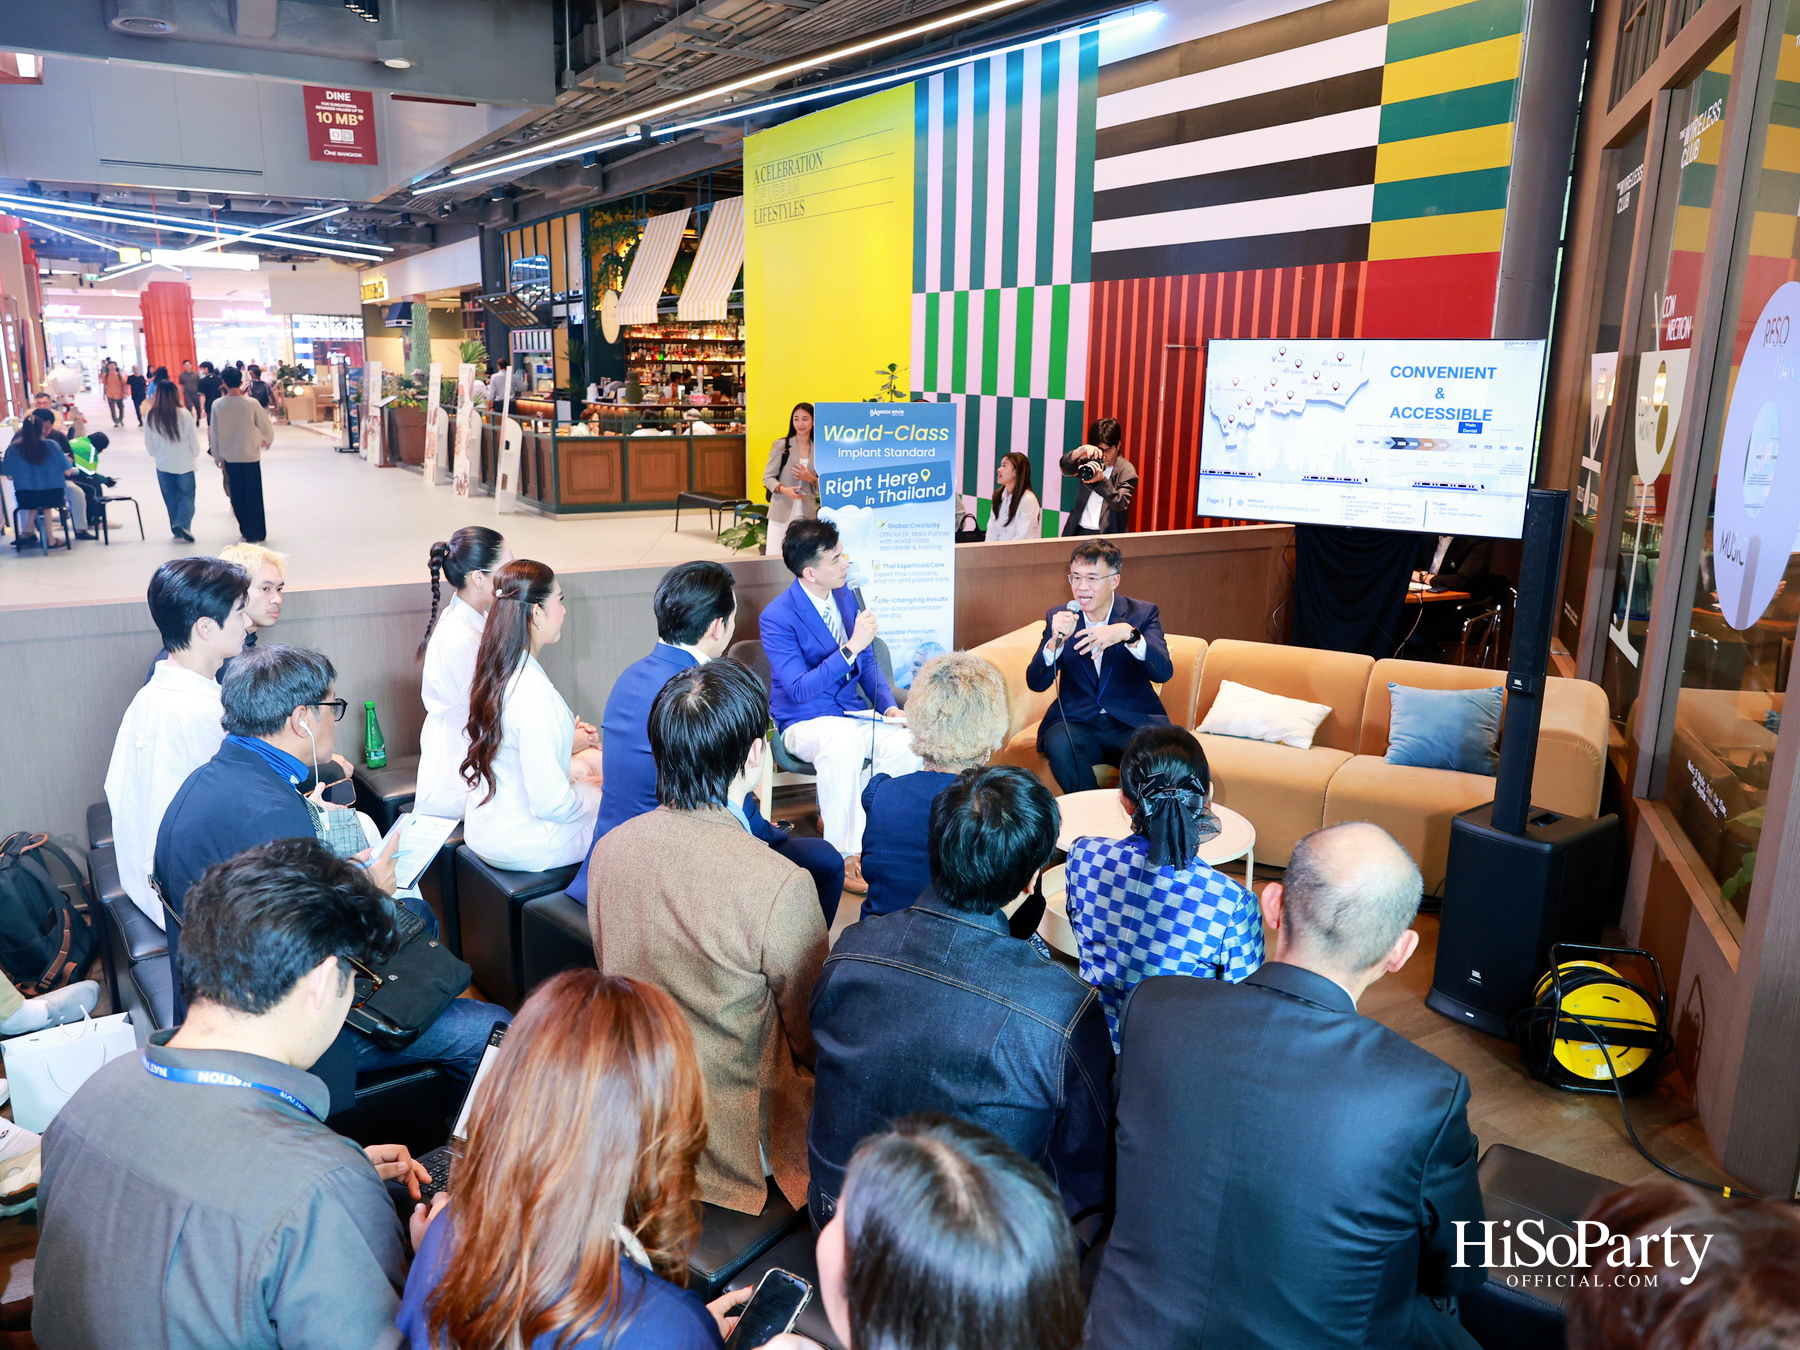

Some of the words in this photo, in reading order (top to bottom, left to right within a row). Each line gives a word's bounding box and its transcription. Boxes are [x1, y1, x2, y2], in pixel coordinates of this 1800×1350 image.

[325, 91, 352, 101] DINE
[316, 112, 332, 124] 10
[1684, 98, 1722, 146] WIRELESS
[1681, 138, 1700, 169] CLUB
[753, 169, 760, 184] A
[760, 151, 823, 183] CELEBRATION
[754, 199, 805, 225] LIFESTYLES
[1663, 294, 1677, 318] CON
[1666, 315, 1693, 341] NECTION
[1390, 366, 1497, 379] CONVENIENT
[1435, 387, 1445, 399] &
[1390, 407, 1493, 421] ACCESSIBLE
[824, 424, 950, 442] World-Class
[838, 448, 881, 460] Implant
[884, 447, 936, 458] Standard
[825, 475, 873, 498] Right
[877, 472, 919, 489] Here
[865, 496, 875, 505] in
[878, 482, 947, 504] Thailand
[918, 544, 943, 552] training
